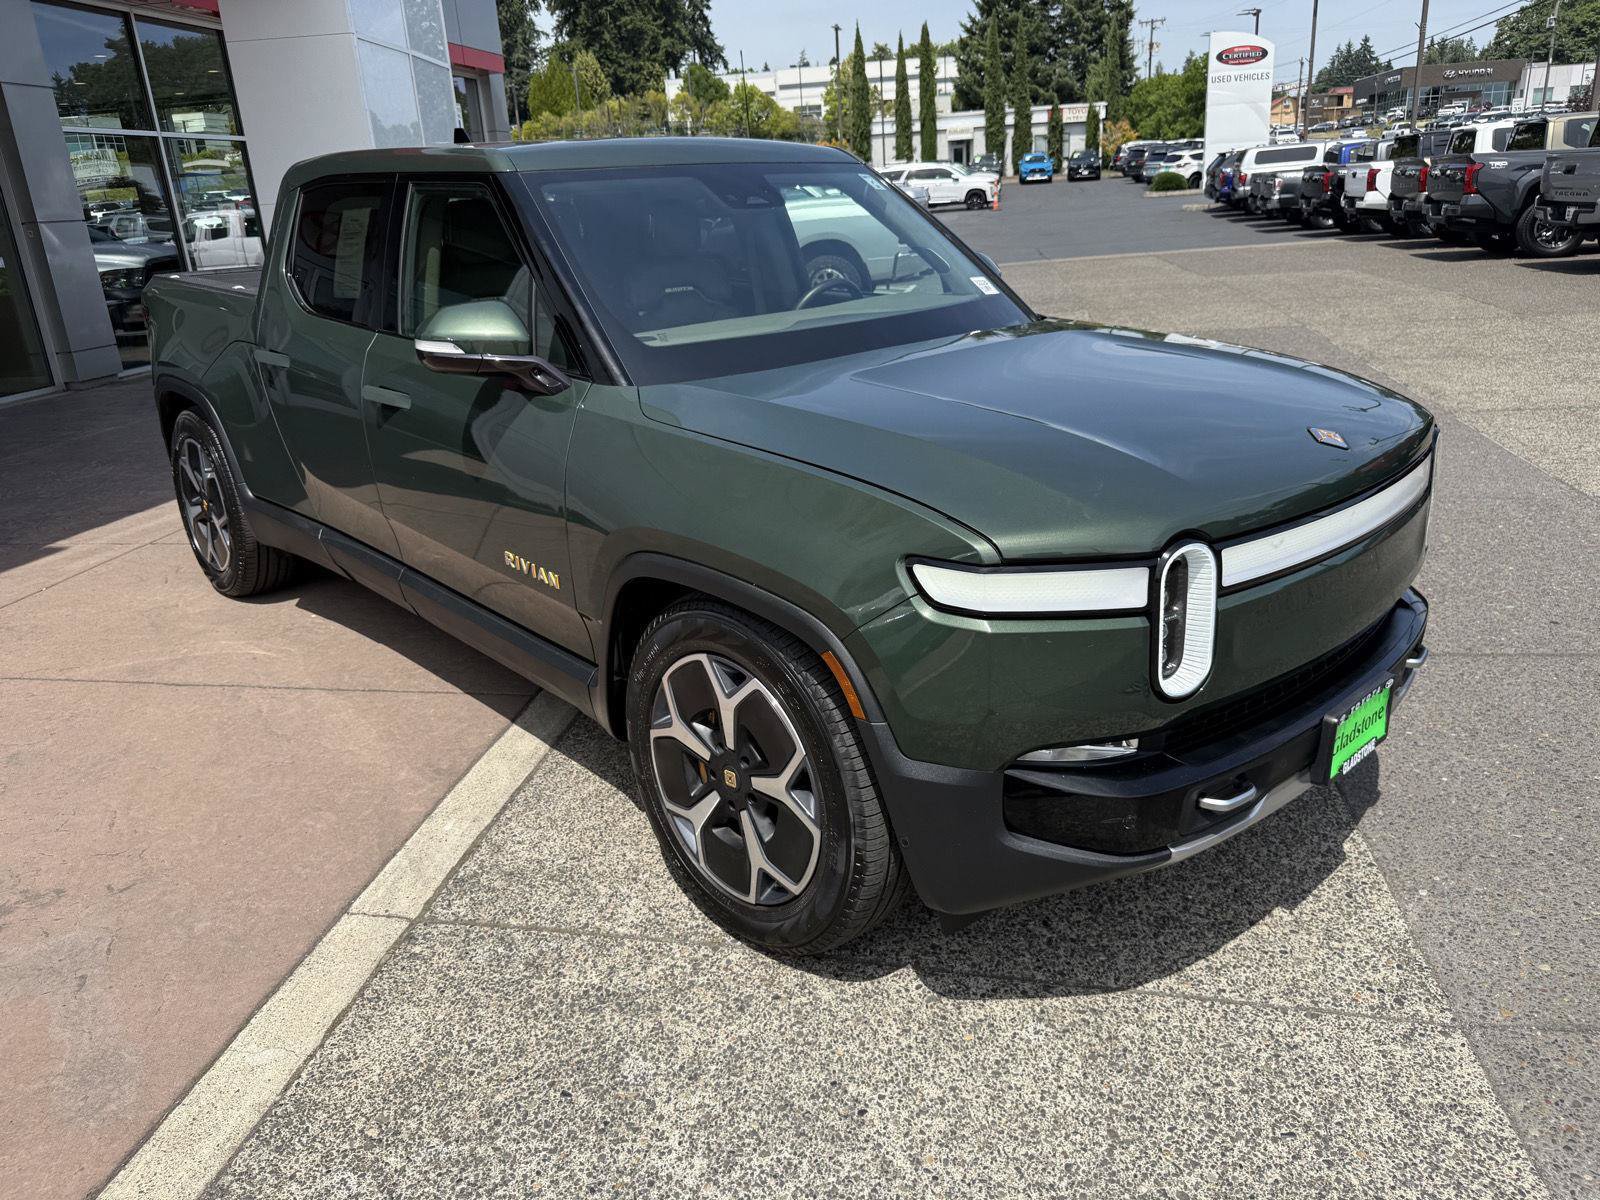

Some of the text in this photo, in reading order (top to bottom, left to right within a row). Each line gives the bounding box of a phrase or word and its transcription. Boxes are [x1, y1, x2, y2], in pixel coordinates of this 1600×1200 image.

[1222, 51, 1262, 60] CERTIFIED
[1211, 72, 1270, 83] USED VEHICLES
[504, 550, 561, 590] RIVIAN
[1342, 738, 1377, 775] GLADSTONE
